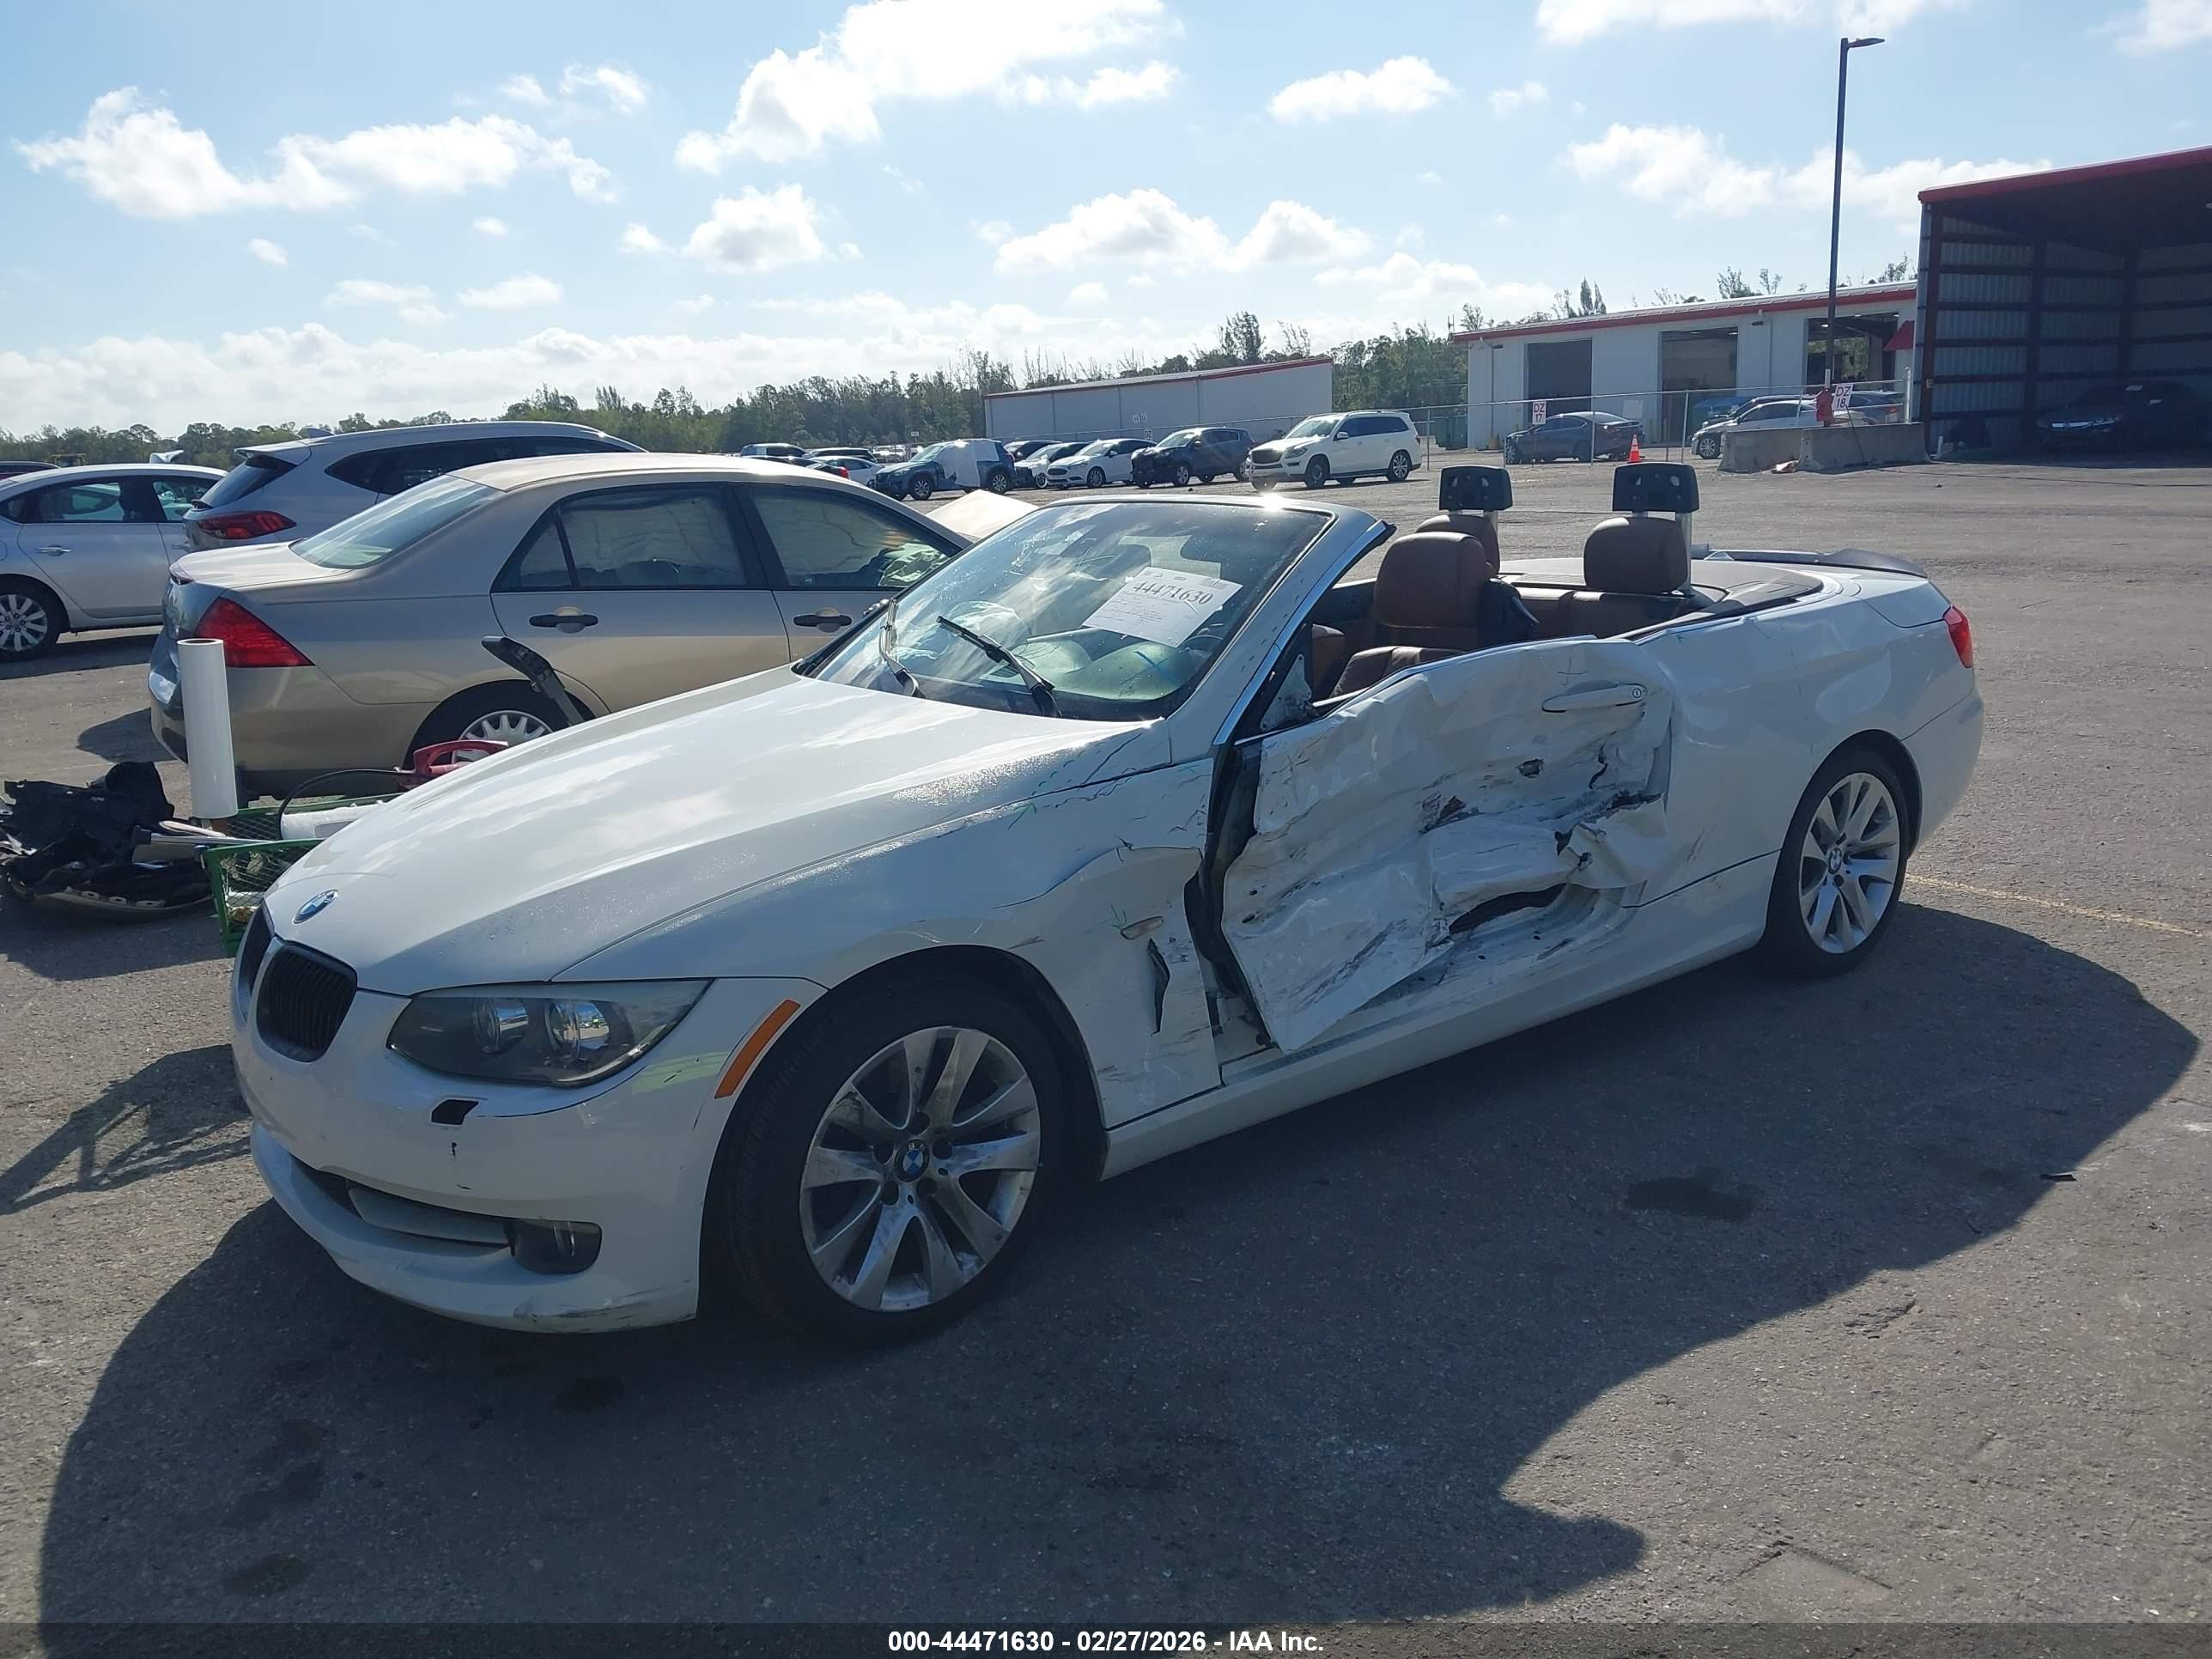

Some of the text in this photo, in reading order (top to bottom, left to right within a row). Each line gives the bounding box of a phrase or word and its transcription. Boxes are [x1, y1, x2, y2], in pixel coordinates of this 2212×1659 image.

[1836, 386, 1851, 397] DZ
[1534, 404, 1545, 412] DZ
[1837, 398, 1845, 408] 18
[1535, 413, 1542, 422] 17
[1133, 581, 1213, 605] 44471630
